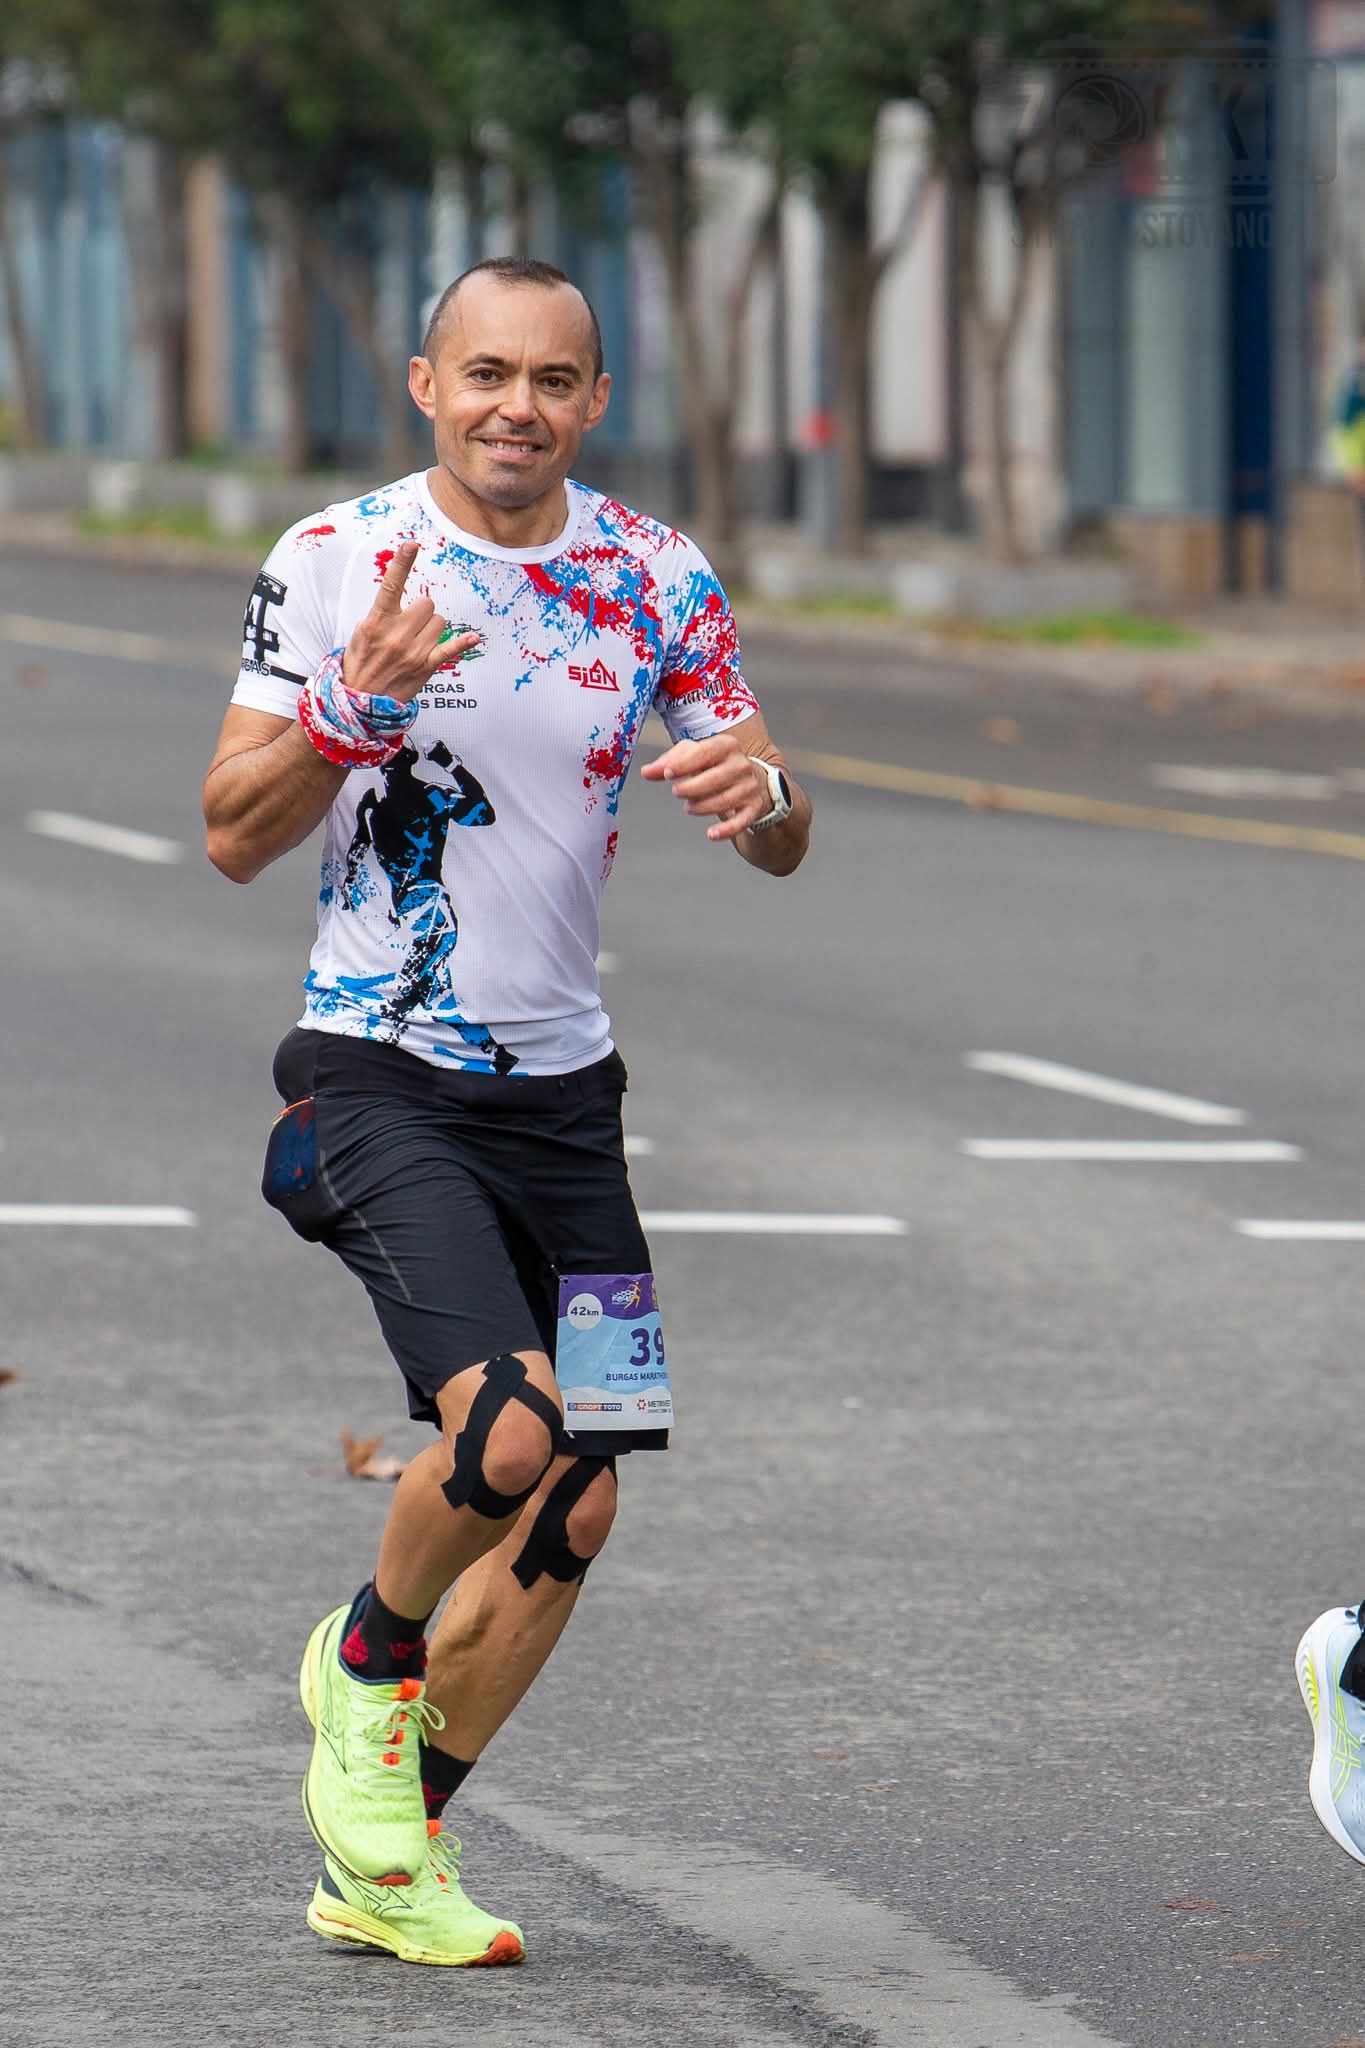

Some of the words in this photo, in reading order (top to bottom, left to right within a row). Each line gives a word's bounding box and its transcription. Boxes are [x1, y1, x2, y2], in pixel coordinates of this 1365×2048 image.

[420, 683, 465, 693] RGAS
[570, 1306, 599, 1316] 42km
[606, 1373, 639, 1381] BURGAS
